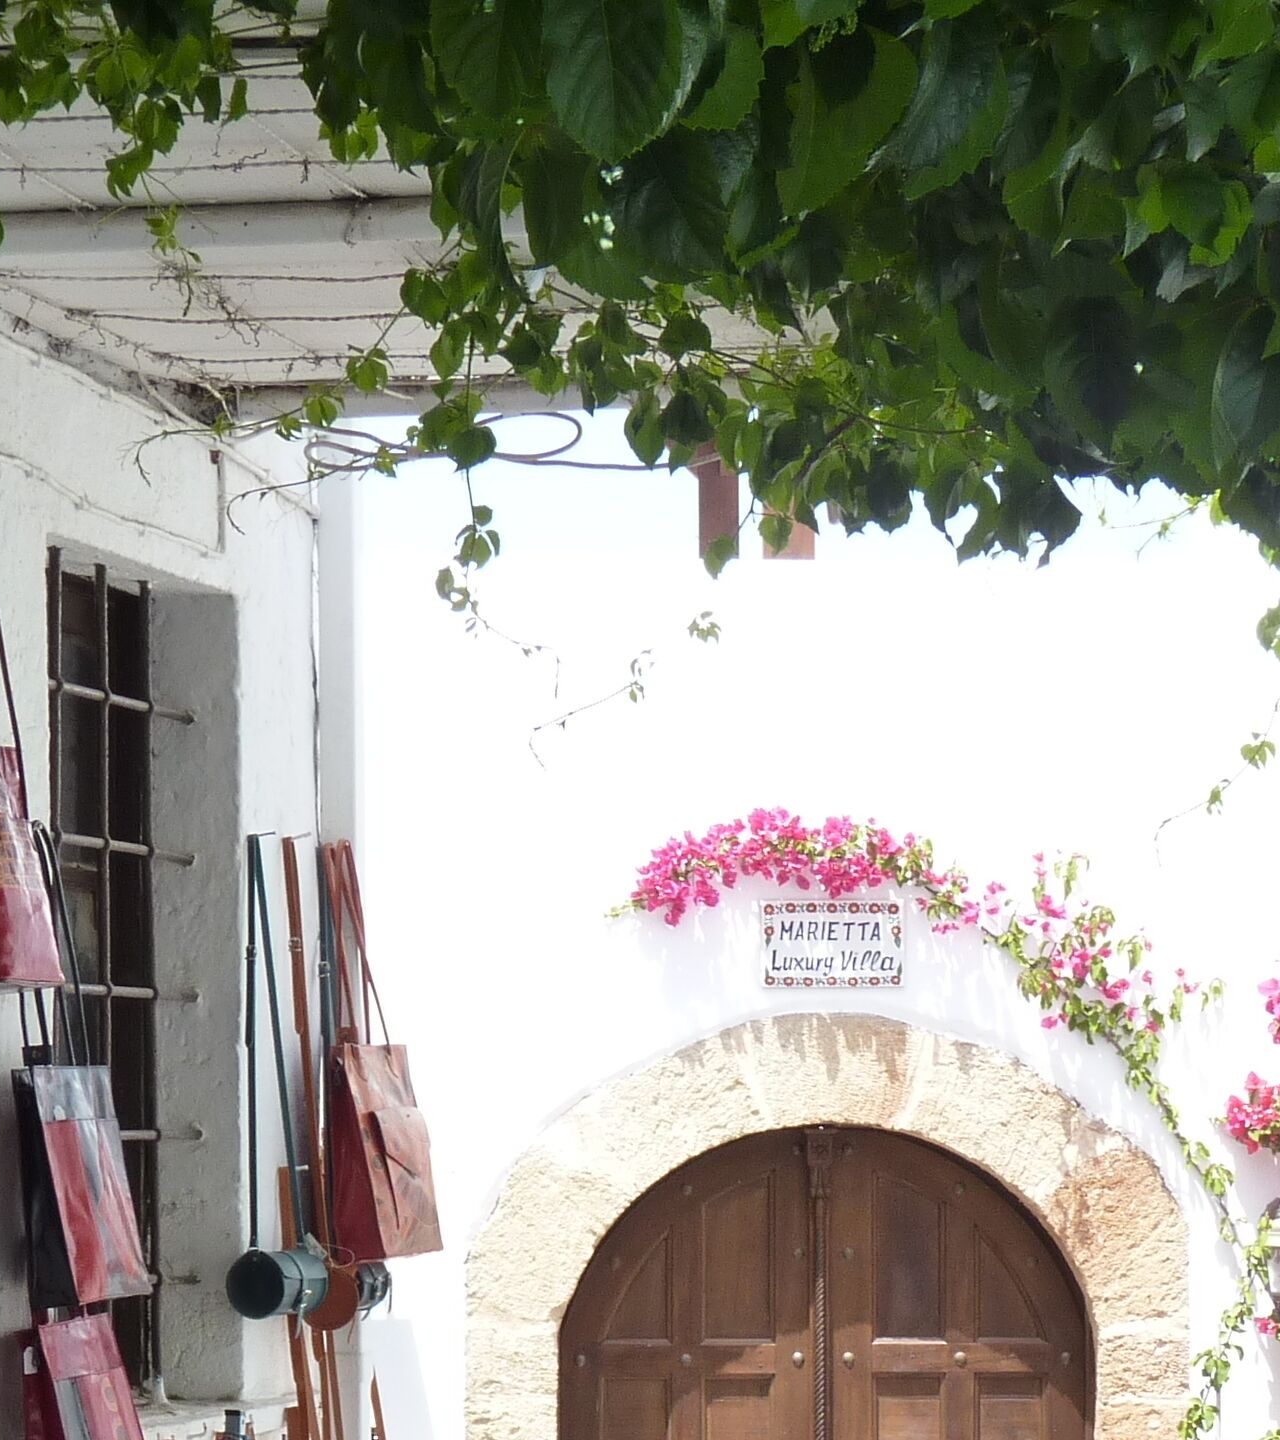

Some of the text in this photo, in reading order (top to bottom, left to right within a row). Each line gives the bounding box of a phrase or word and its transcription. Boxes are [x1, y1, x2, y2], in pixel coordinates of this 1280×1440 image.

[779, 920, 881, 941] MARIETTA
[772, 949, 895, 976] Luxury Villa
